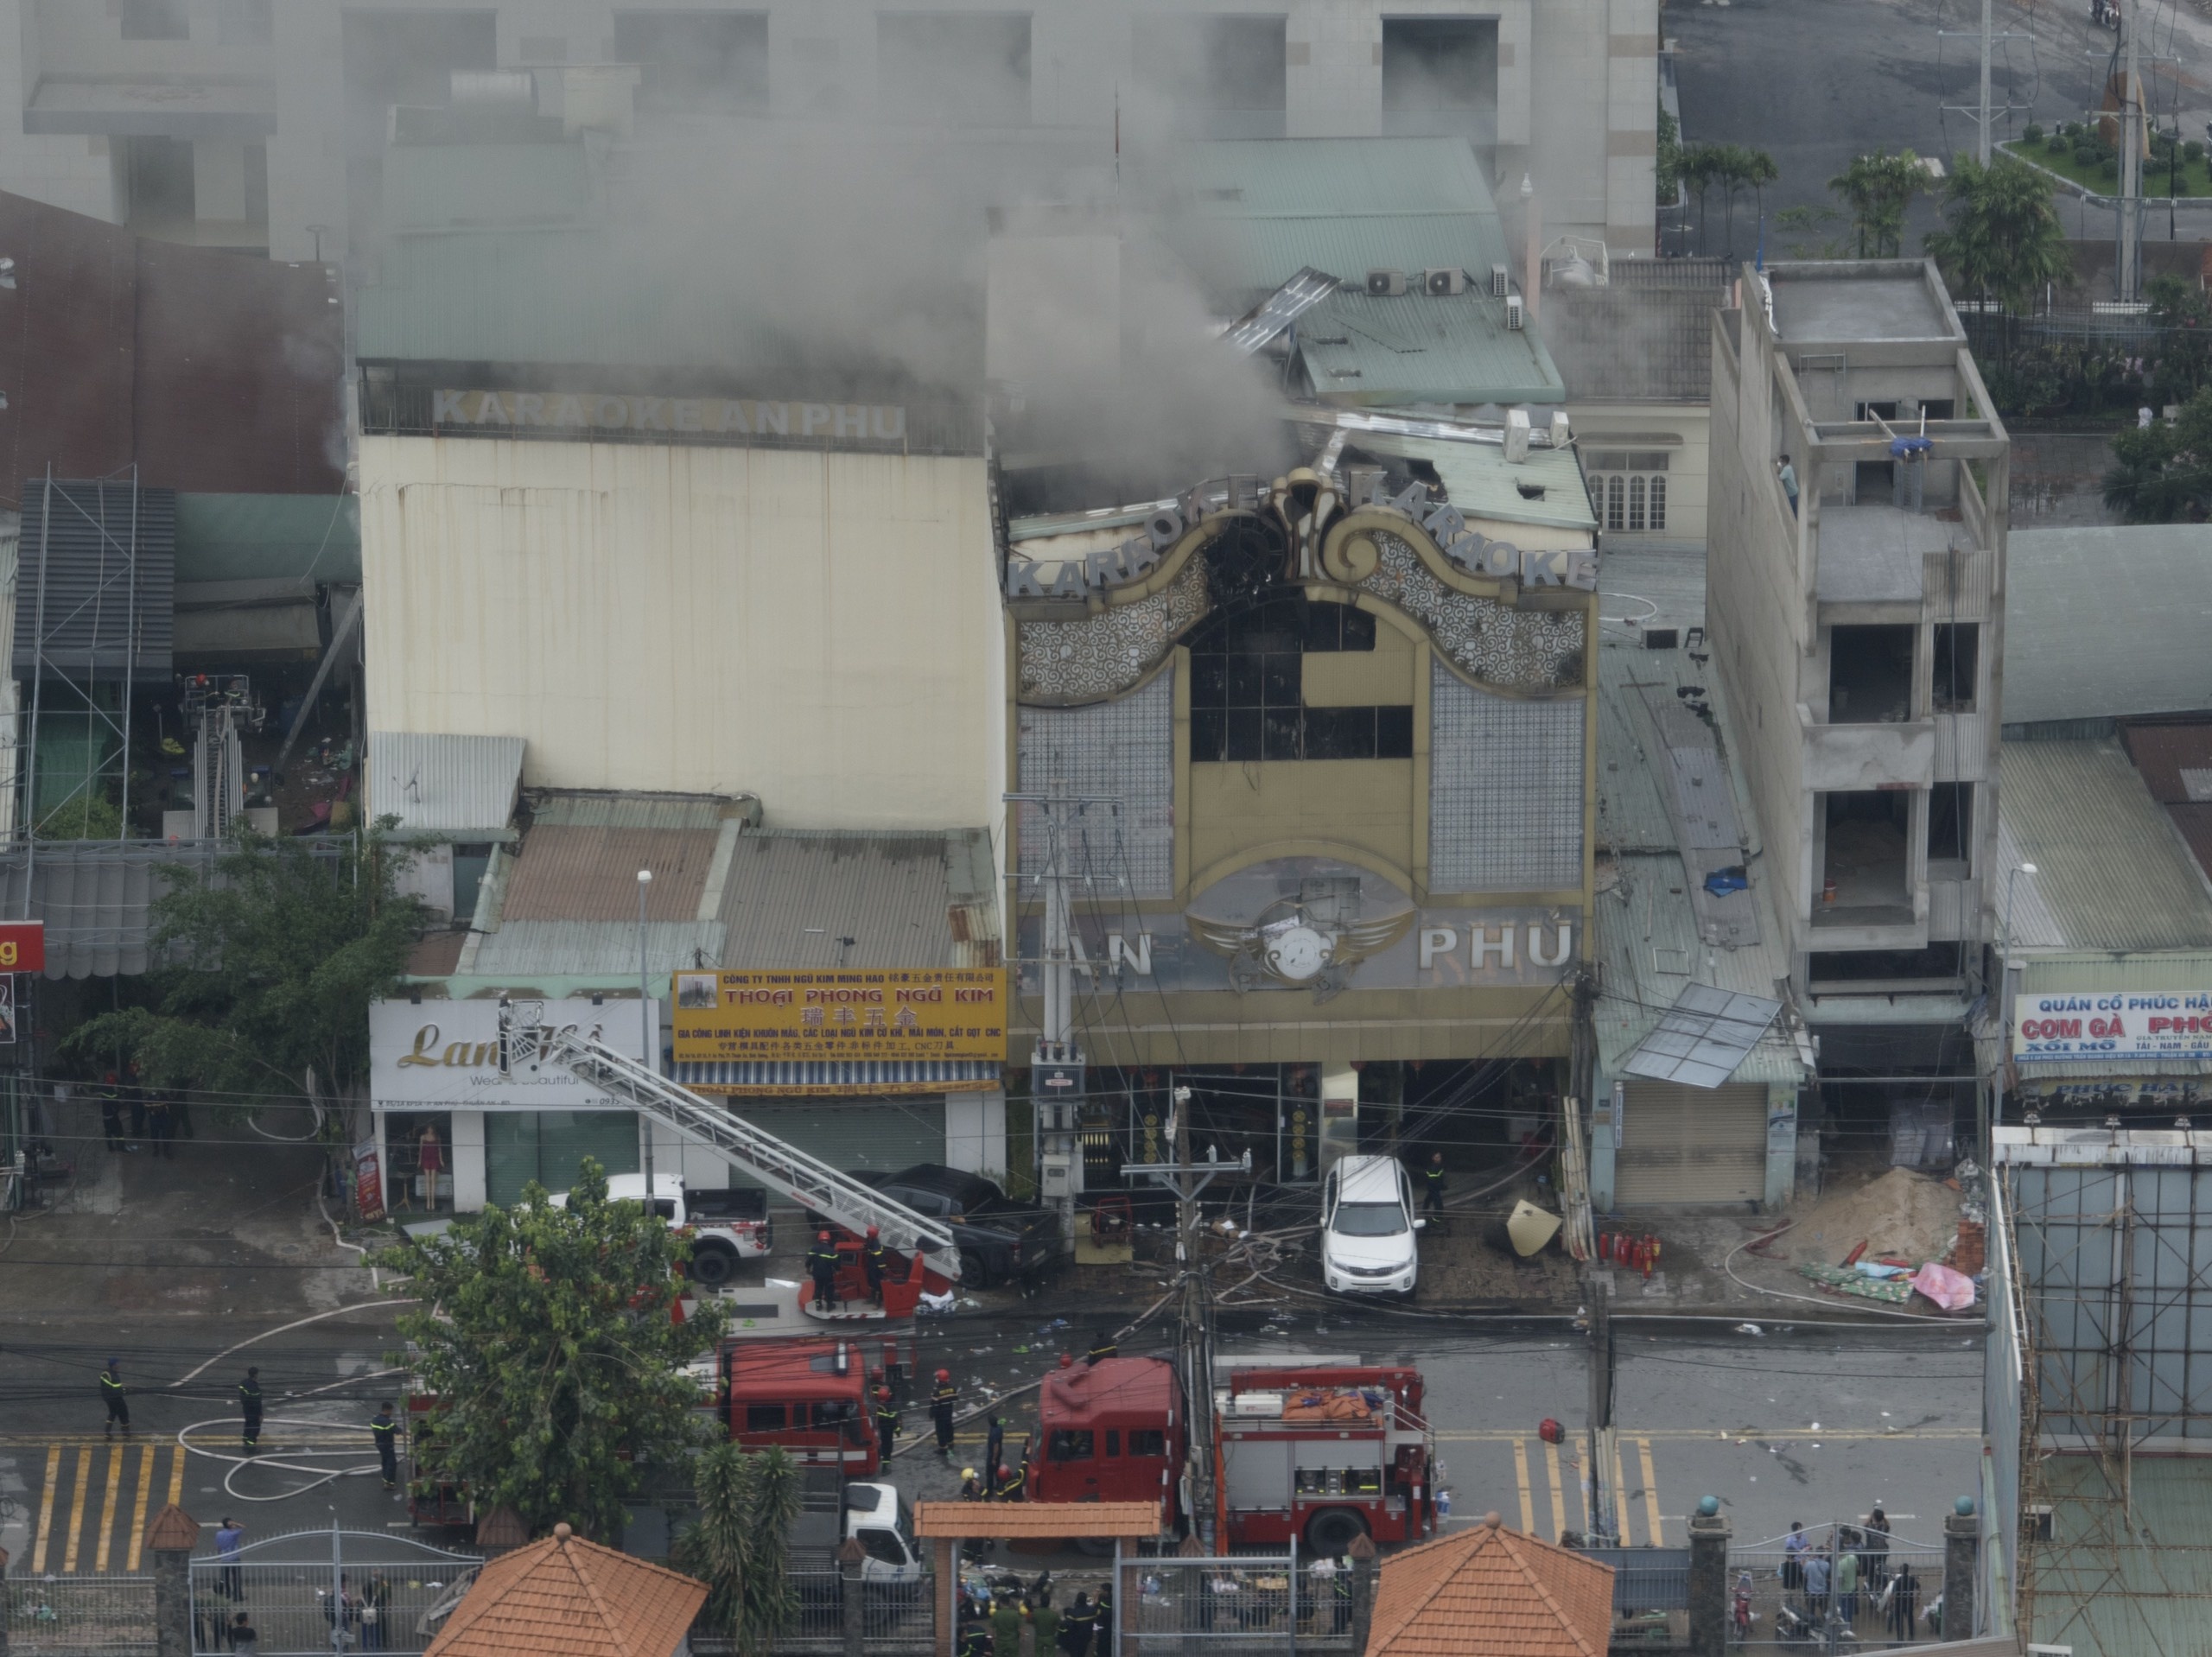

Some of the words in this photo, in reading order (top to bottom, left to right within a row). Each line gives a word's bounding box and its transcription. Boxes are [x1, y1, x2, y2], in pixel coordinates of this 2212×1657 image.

[433, 390, 705, 431] KARAOKE
[715, 398, 789, 435] AN
[802, 403, 906, 439] PHU
[1007, 473, 1260, 600] KARAOKE
[1350, 471, 1601, 592] KARAOKE
[723, 974, 749, 984] CÔNG
[752, 975, 764, 984] TY
[766, 975, 791, 984] TNHH
[793, 973, 813, 984] NGŨ
[816, 975, 835, 984] KIM
[837, 975, 862, 983] MING
[865, 975, 884, 983] HAO
[724, 988, 794, 1008] THOẠI
[805, 987, 882, 1004] PHONG
[895, 984, 943, 1003] NGŨ
[954, 987, 994, 1003] KIM
[2039, 996, 2092, 1013] QUÁN
[2128, 994, 2179, 1011] PHÚC
[2185, 994, 2212, 1012] HẬ
[800, 1005, 918, 1027] 瑞丰五金
[2021, 1018, 2082, 1039] CƠM
[2088, 1013, 2126, 1038] GÀ
[677, 1029, 690, 1038] GIA
[692, 1027, 712, 1038] CÔNG
[859, 1028, 874, 1038] KIM
[985, 1028, 1001, 1038] CNC
